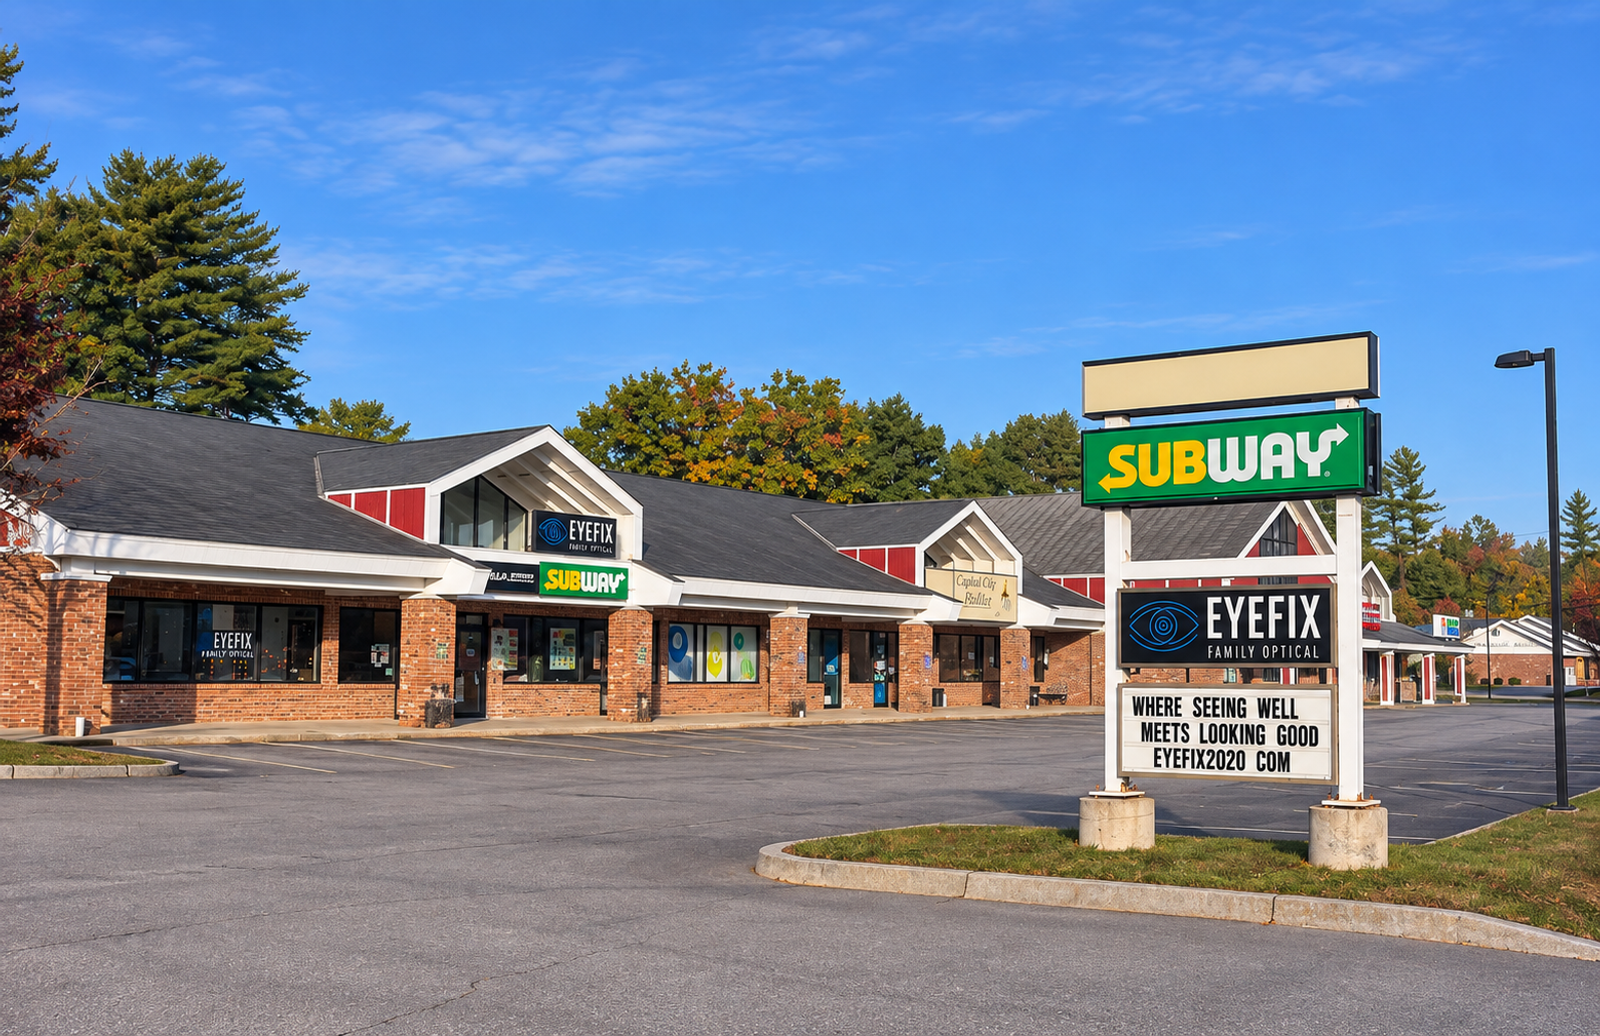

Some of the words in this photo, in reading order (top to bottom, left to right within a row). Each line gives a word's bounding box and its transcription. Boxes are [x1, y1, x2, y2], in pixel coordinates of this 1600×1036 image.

[1098, 423, 1349, 494] SUBWAY
[569, 520, 613, 544] EYEFIX
[544, 569, 626, 594] SUBWAY
[1207, 595, 1321, 639] EYEFIX
[214, 631, 252, 650] EYEFIX
[1208, 645, 1255, 659] FAMILY
[1262, 645, 1320, 659] OPTICAL
[1132, 696, 1182, 718] WHERE
[1192, 697, 1247, 719] SEEING
[1257, 697, 1299, 720] WELL
[1141, 722, 1190, 744] MEETS
[1199, 723, 1266, 746] LOOKING
[1276, 725, 1319, 747] GOOD
[1153, 747, 1246, 772] EYEFIX2020
[1256, 750, 1291, 773] COM
